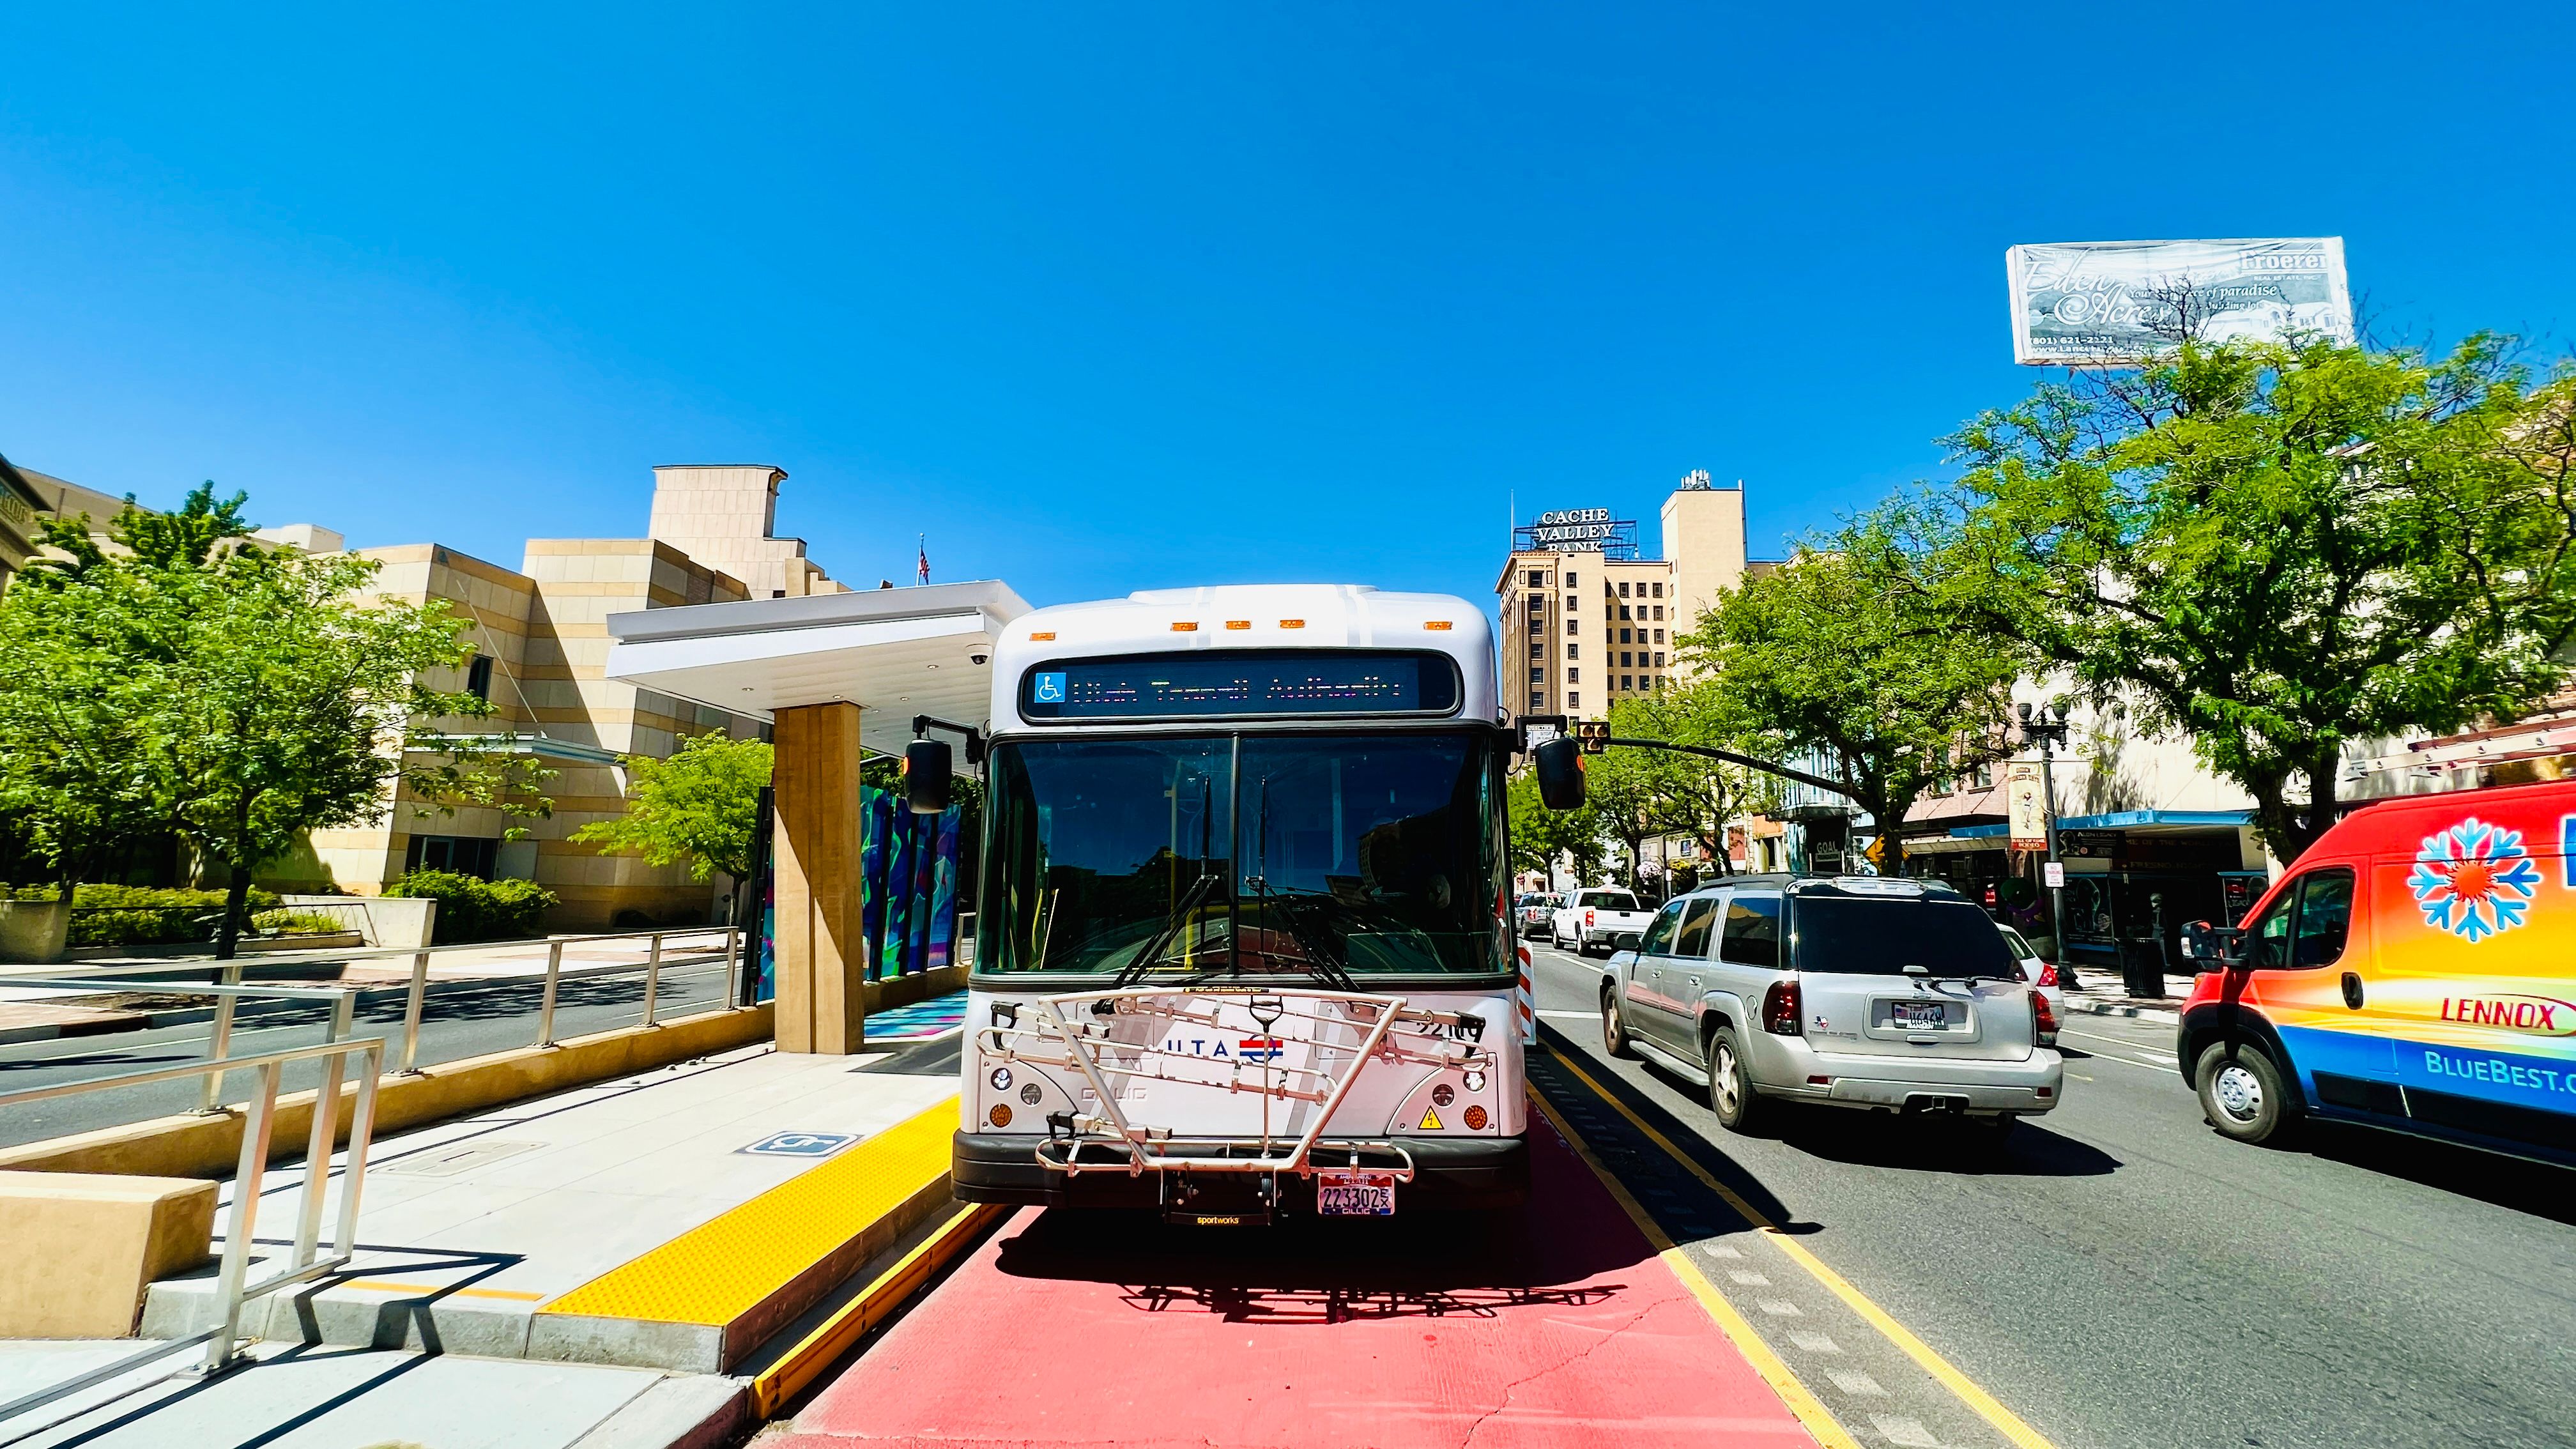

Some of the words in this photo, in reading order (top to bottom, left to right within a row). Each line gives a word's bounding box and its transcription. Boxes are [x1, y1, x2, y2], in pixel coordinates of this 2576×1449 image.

[2025, 247, 2115, 294] Eden
[2129, 289, 2152, 298] Your
[2220, 283, 2278, 300] paradise
[2054, 283, 2165, 325] Acres
[2030, 337, 2057, 345] (801)
[1541, 508, 1609, 525] CACHE
[1537, 523, 1614, 541] VALLEY
[2441, 997, 2556, 1031] LENNOX
[1168, 1039, 1229, 1057] UTA
[1082, 1087, 1148, 1101] GLIG
[1324, 1188, 1379, 1208] 223302
[1197, 1216, 1239, 1225] sportworks
